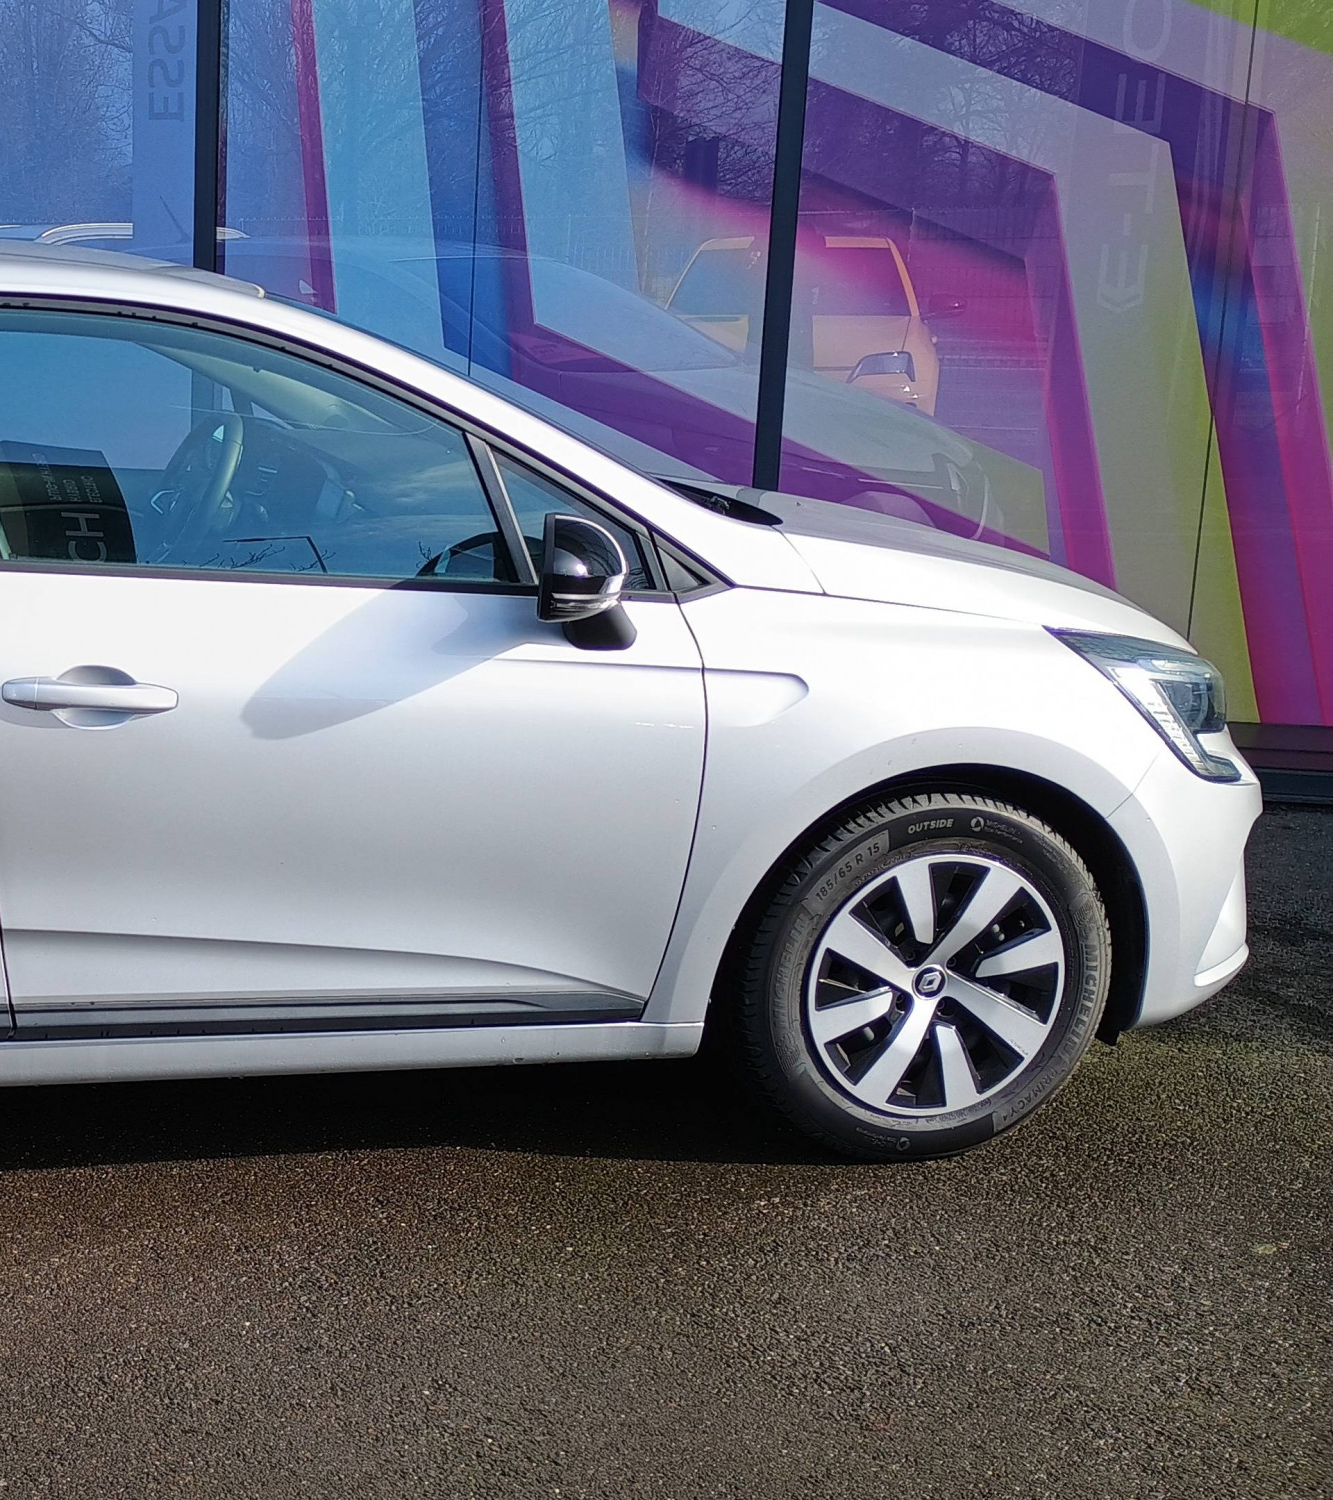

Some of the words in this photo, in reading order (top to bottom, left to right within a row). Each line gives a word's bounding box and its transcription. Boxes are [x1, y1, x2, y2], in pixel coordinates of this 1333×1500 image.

[908, 818, 954, 834] OUTSIDE
[816, 861, 853, 901] 185/65
[855, 853, 864, 865] R
[867, 842, 881, 856] 15
[1064, 944, 1099, 1060] MICHELIN
